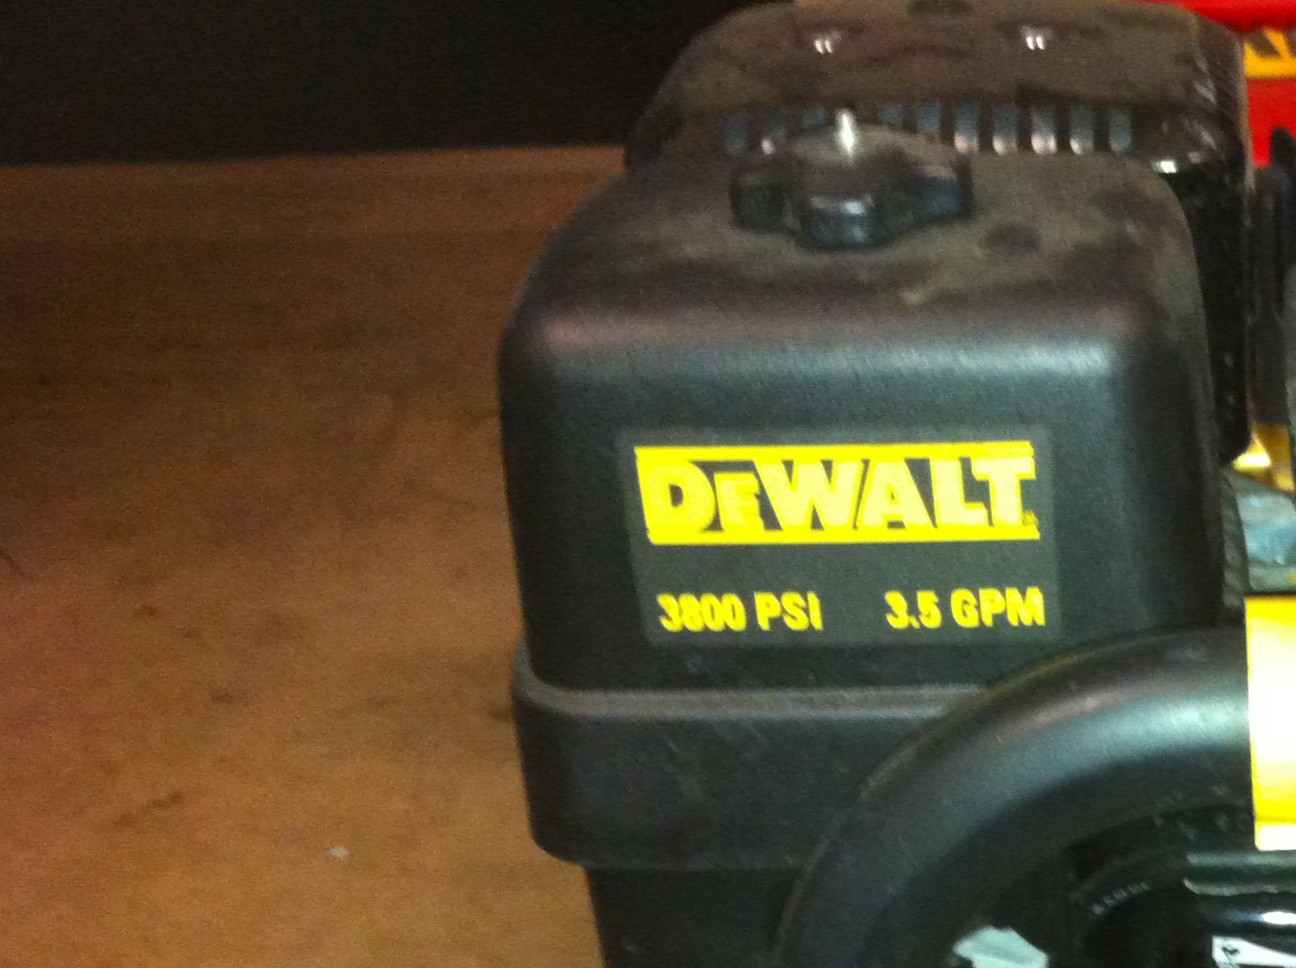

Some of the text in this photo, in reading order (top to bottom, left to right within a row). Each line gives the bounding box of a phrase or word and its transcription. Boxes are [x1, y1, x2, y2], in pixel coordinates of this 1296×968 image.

[637, 448, 1037, 542] DEWALT
[657, 586, 1045, 632] 3800 PSI 3.5 GPM
